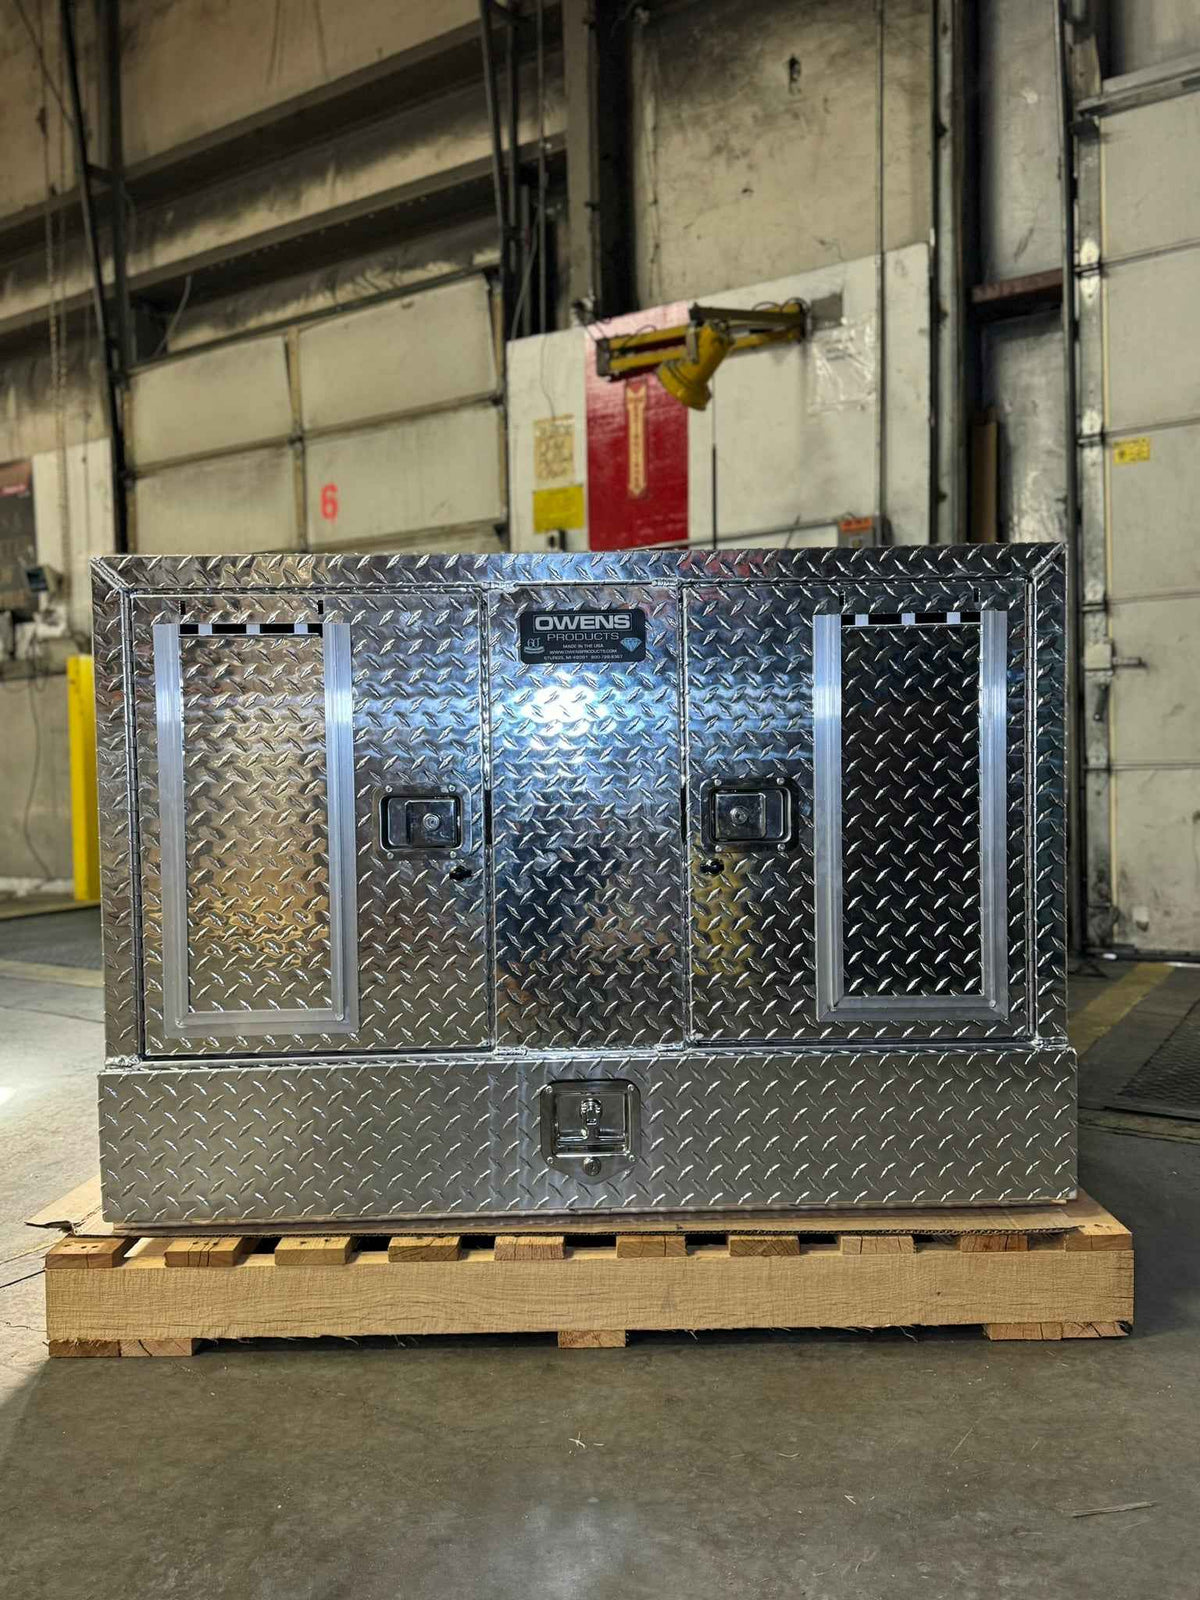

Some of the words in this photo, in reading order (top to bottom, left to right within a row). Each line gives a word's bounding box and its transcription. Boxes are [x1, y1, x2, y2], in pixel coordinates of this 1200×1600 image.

[320, 482, 338, 521] 6
[535, 615, 631, 630] OWENS
[547, 632, 619, 641] PRODUCTS
